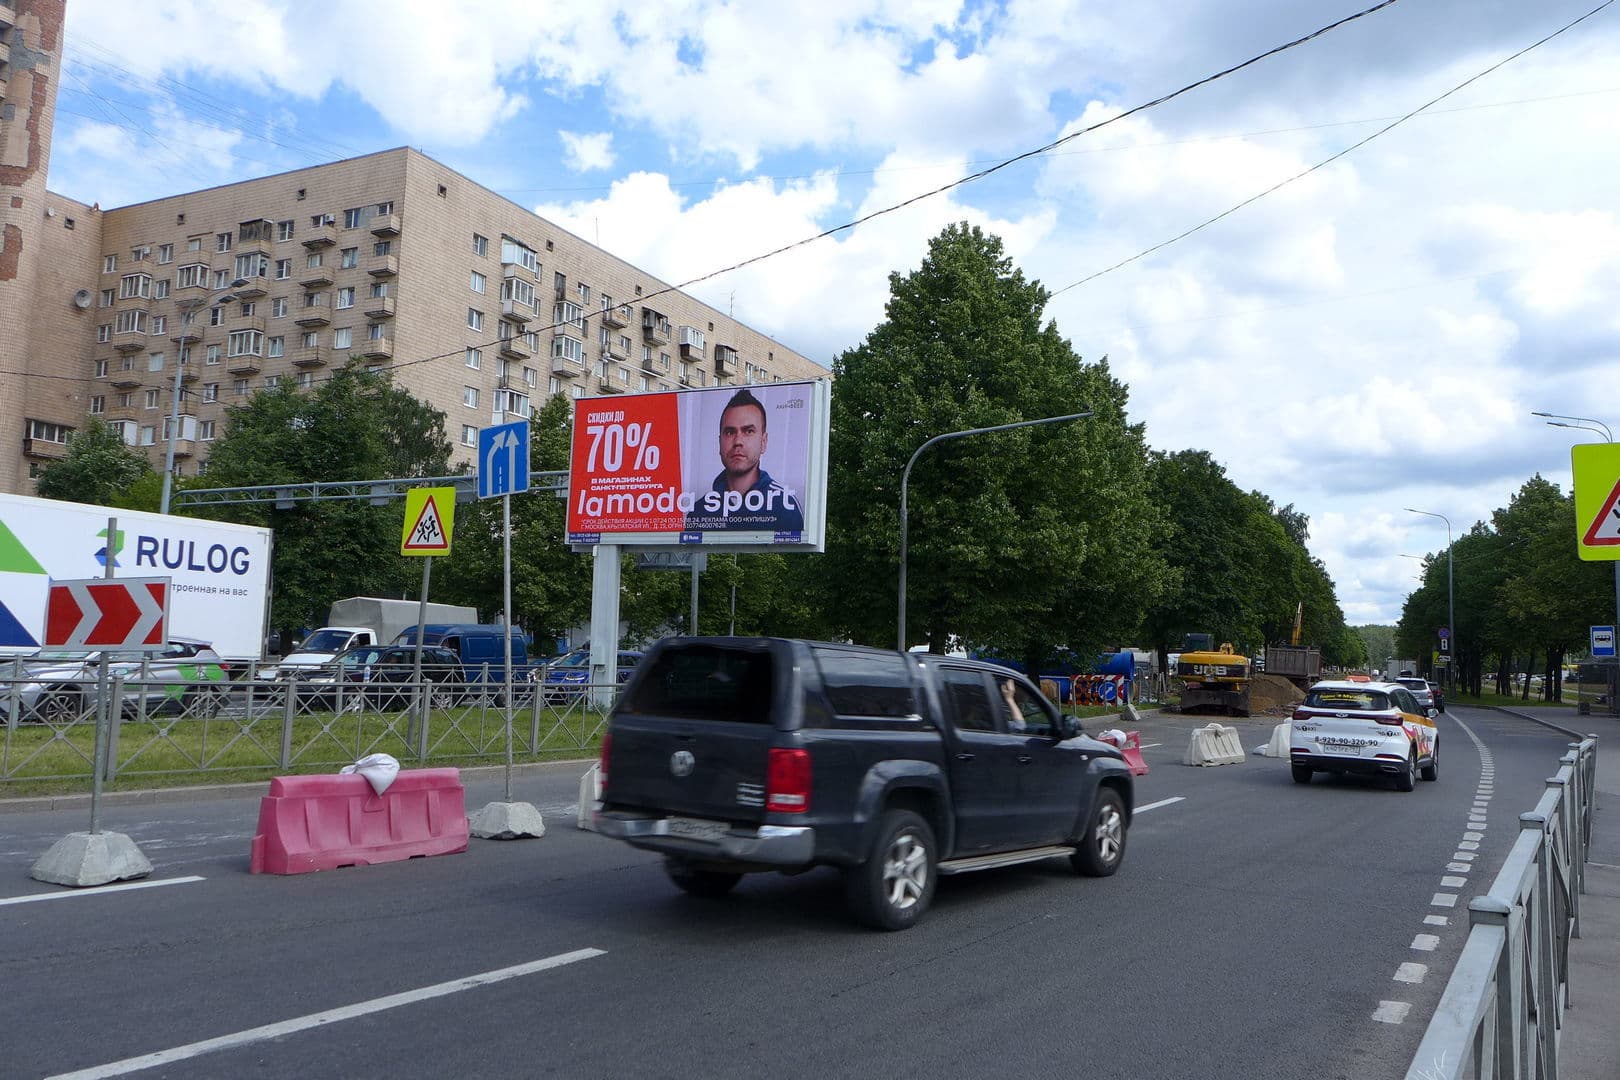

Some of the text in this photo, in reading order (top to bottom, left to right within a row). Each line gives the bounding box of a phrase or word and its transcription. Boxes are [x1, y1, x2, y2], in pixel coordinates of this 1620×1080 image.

[587, 411, 624, 424] СКИДКИ ДО
[586, 422, 660, 473] 70%
[598, 476, 651, 484] МАГАЗИНАХ
[590, 483, 663, 491] САНКТ-ПЕТЕРБУРГА
[577, 486, 796, 517] lamoda sport
[136, 535, 250, 575] RULOG
[172, 583, 248, 596] троенная на вас
[1314, 735, 1378, 747] 8-929-90-320-90
